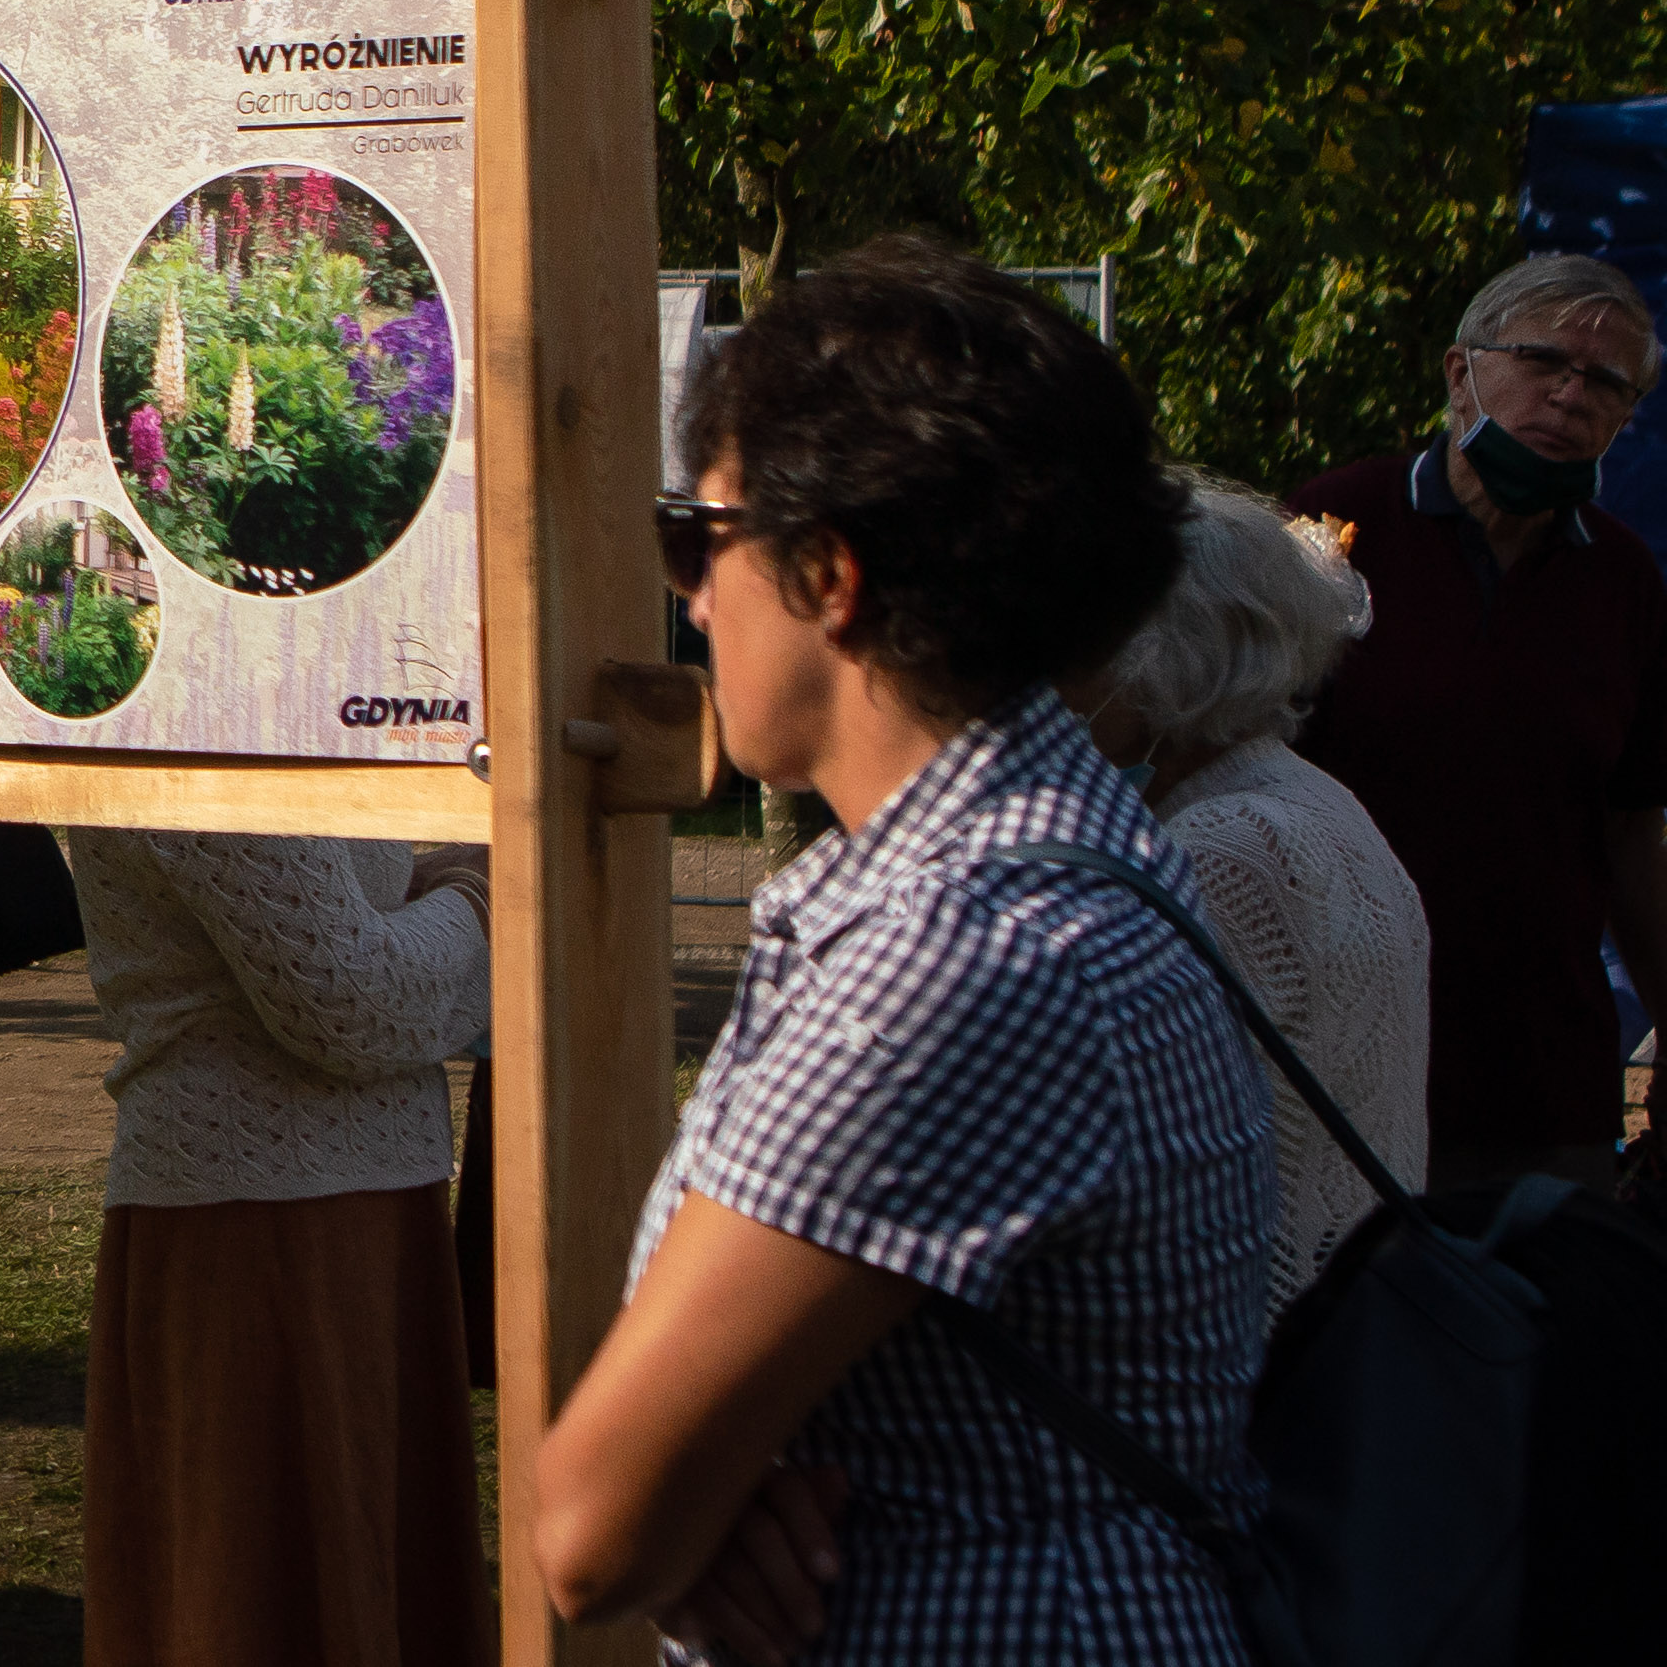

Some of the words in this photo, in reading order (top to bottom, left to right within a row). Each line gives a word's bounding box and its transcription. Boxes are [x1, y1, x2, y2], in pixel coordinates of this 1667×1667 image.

[238, 33, 465, 75] WYRÓŻNIENIE
[237, 88, 351, 114] Gertruda
[363, 83, 464, 107] Daniluk
[341, 696, 470, 728] GDYNIA
